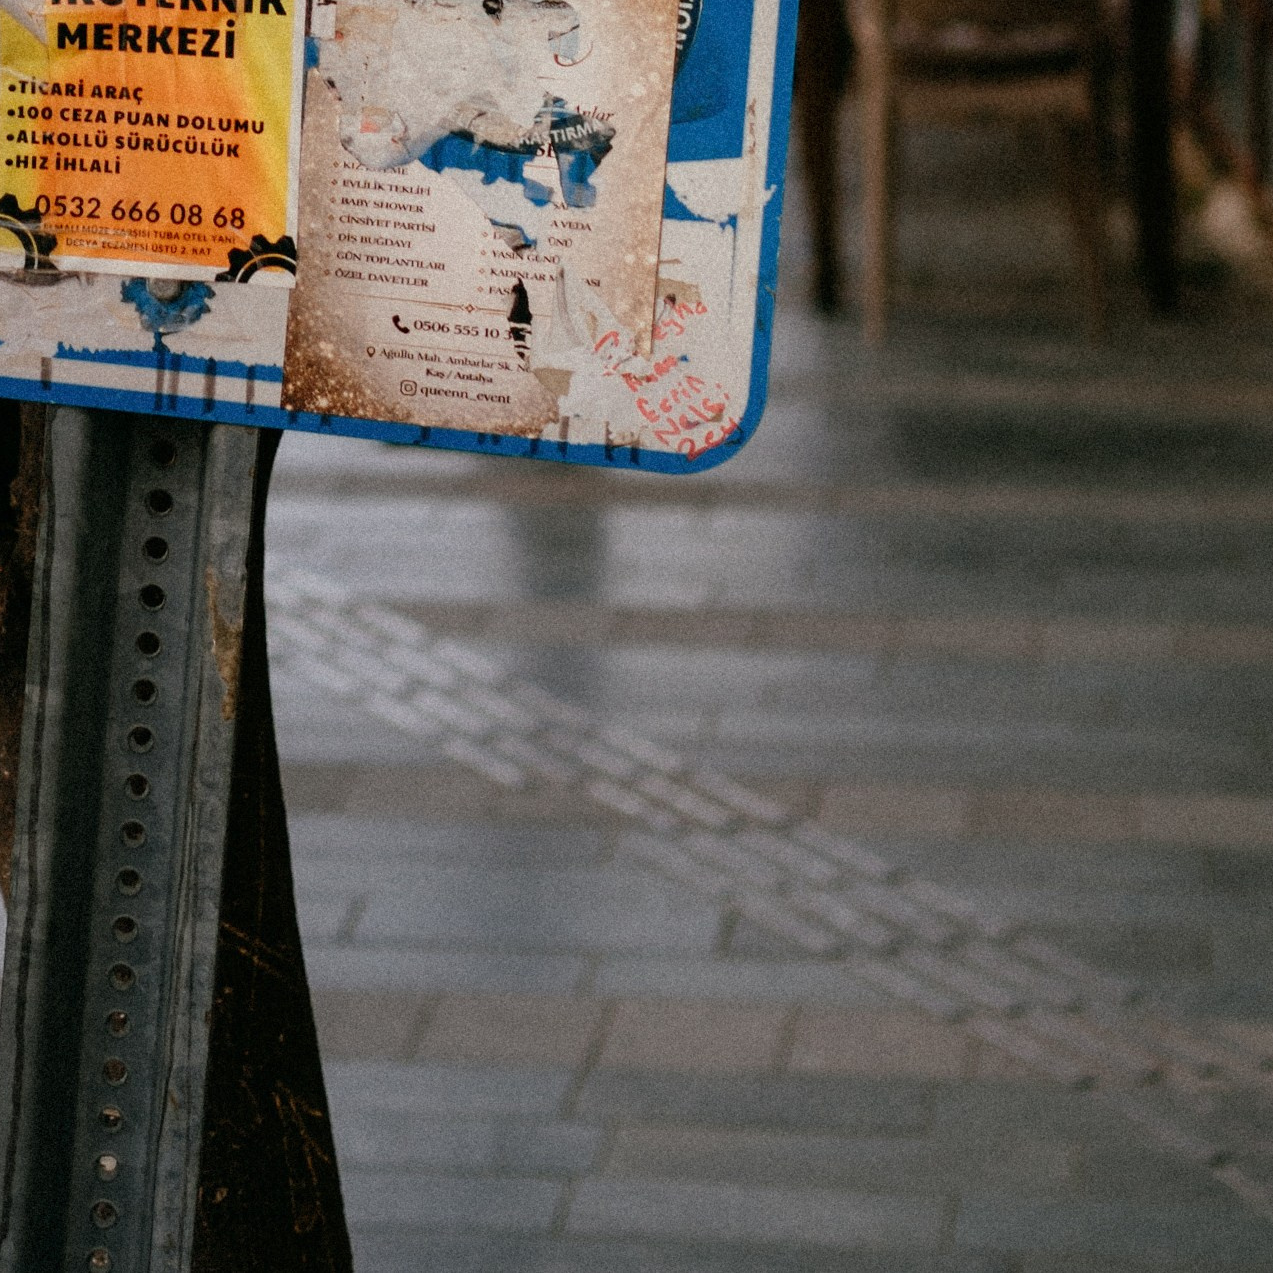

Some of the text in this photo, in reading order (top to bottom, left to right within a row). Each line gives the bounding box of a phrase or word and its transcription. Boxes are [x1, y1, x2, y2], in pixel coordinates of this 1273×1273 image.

[57, 19, 235, 58] MERKEZİ
[19, 76, 143, 105] TİCARİ ARAÇ
[17, 106, 265, 134] 100 CEZA PUAN DOLUMU
[16, 129, 240, 158] ALKOLLÜ SÜRÜCÜLÜK
[15, 152, 121, 174] HIZ İHLALİ
[35, 194, 246, 230] 0532 666 08 68
[341, 197, 424, 213] BABY SHOWER
[153, 230, 180, 241] TUBA
[183, 233, 208, 243] OTEL
[548, 237, 573, 248] ÜNÜ
[192, 246, 212, 256] KAT
[365, 256, 446, 271] TOPLANTILARI
[335, 268, 428, 287] ÖZEL DAVETLER
[413, 319, 450, 334] 0506
[454, 324, 479, 337] 555
[446, 355, 494, 369] Ambarlar
[454, 370, 493, 384] Antalya
